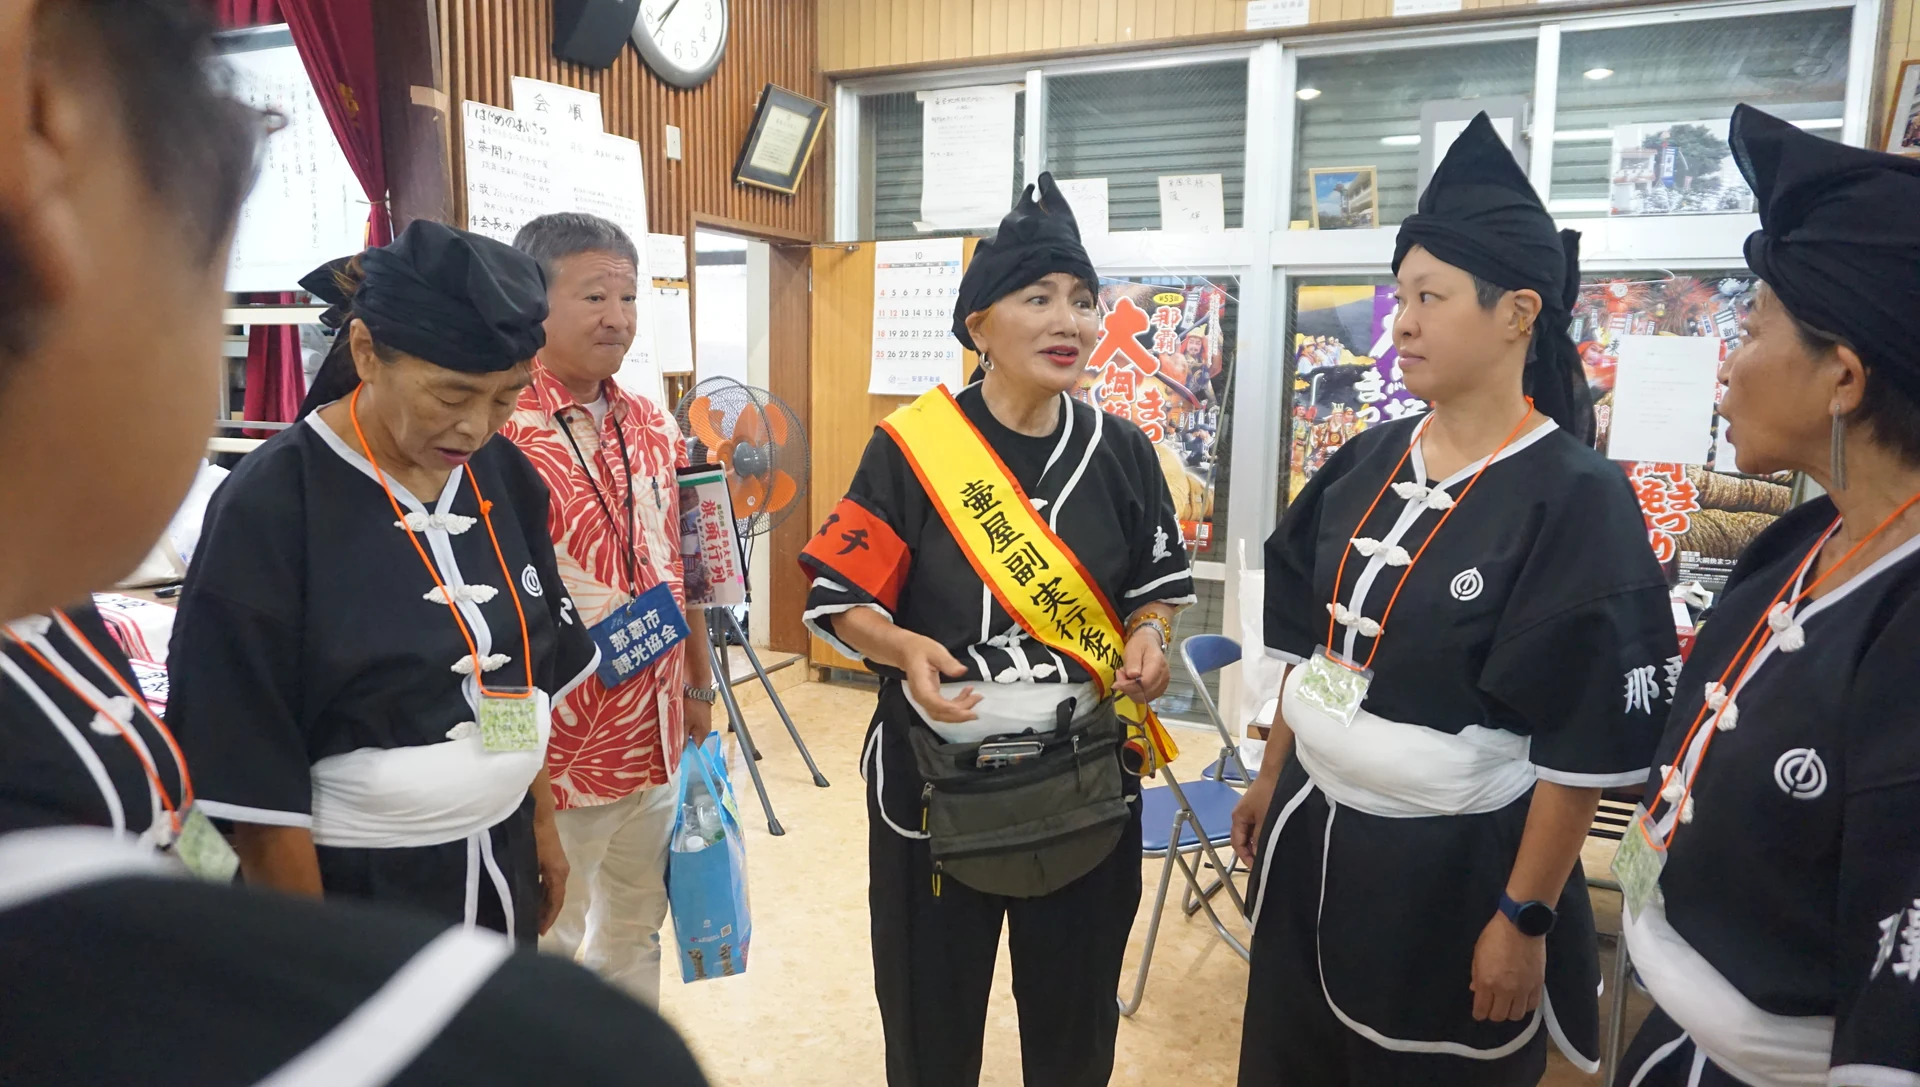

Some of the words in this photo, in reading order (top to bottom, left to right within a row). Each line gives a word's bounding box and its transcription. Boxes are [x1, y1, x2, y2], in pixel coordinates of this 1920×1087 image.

[645, 5, 654, 25] 8
[704, 2, 712, 21] 3
[658, 28, 665, 47] 7
[699, 26, 707, 43] 4
[674, 41, 683, 60] 6
[690, 40, 699, 58] 5
[914, 252, 923, 260] 10
[879, 289, 885, 297] 4
[891, 289, 897, 297] 5
[902, 289, 908, 297] 6
[914, 288, 920, 296] 7
[926, 288, 931, 296] 8
[938, 288, 943, 296] 9
[948, 287, 957, 295] 10
[878, 310, 886, 318] 11
[889, 309, 898, 317] 12
[901, 309, 909, 317] 13
[912, 309, 921, 317] 14
[924, 309, 932, 317] 15
[936, 309, 944, 317] 16
[877, 330, 886, 338] 18
[888, 330, 897, 338] 19
[899, 330, 909, 338] 20
[911, 330, 919, 338] 21
[922, 330, 932, 338] 22
[934, 330, 944, 338] 23
[1152, 306, 1181, 352] 那覇
[608, 608, 661, 653] 那覇市
[611, 624, 679, 676] 観光協会
